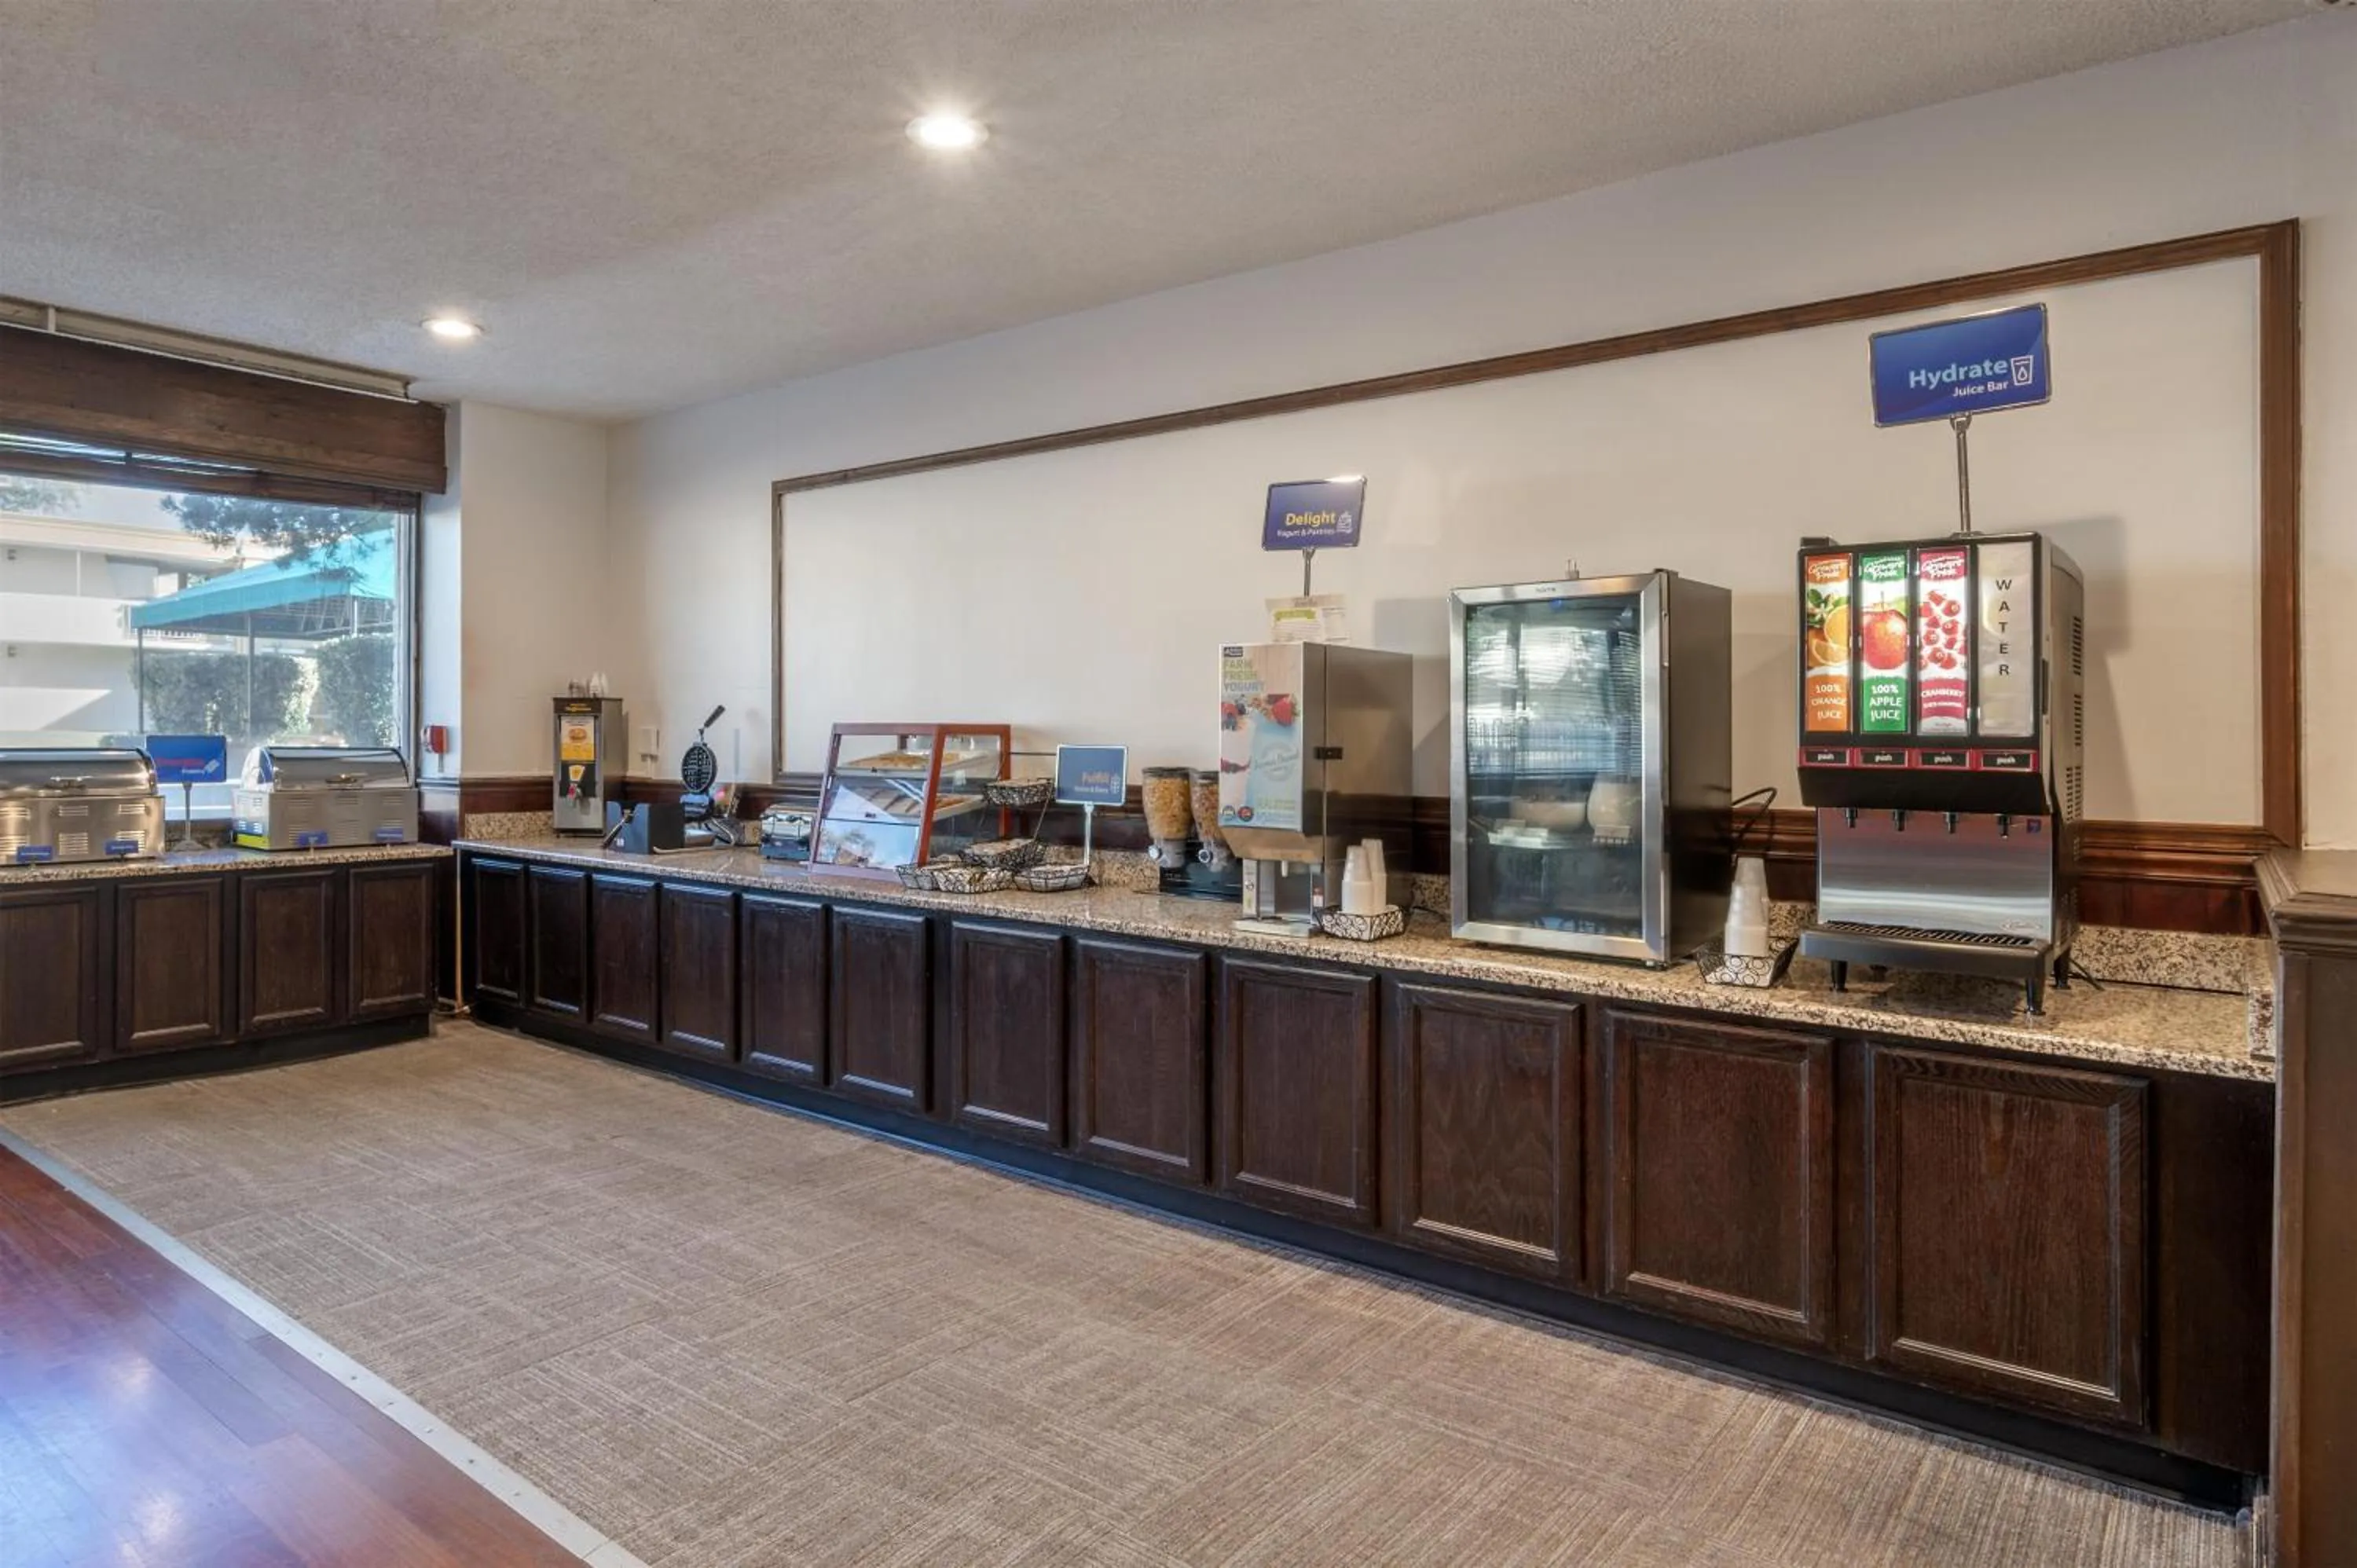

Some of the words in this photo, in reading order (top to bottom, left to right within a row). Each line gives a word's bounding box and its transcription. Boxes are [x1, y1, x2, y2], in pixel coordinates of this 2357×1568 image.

[1908, 359, 2008, 390] Hydrate
[1952, 384, 1985, 397] Juice
[1987, 381, 2009, 392] Bar
[1285, 511, 1336, 527] Delight
[1996, 580, 2012, 676] WATER
[1223, 681, 1264, 692] YOGURT
[1816, 683, 1842, 694] 100%
[1871, 683, 1899, 694] 100%
[1921, 688, 1964, 698] CRANBERRY
[1811, 697, 1847, 706] ORANGE
[1869, 697, 1904, 707] APPLE
[1817, 709, 1842, 720] JUICE
[1871, 709, 1901, 722] JUICE
[1817, 753, 1835, 761] push
[1875, 754, 1893, 763] push
[1934, 755, 1952, 764] push
[1996, 756, 2016, 765] push
